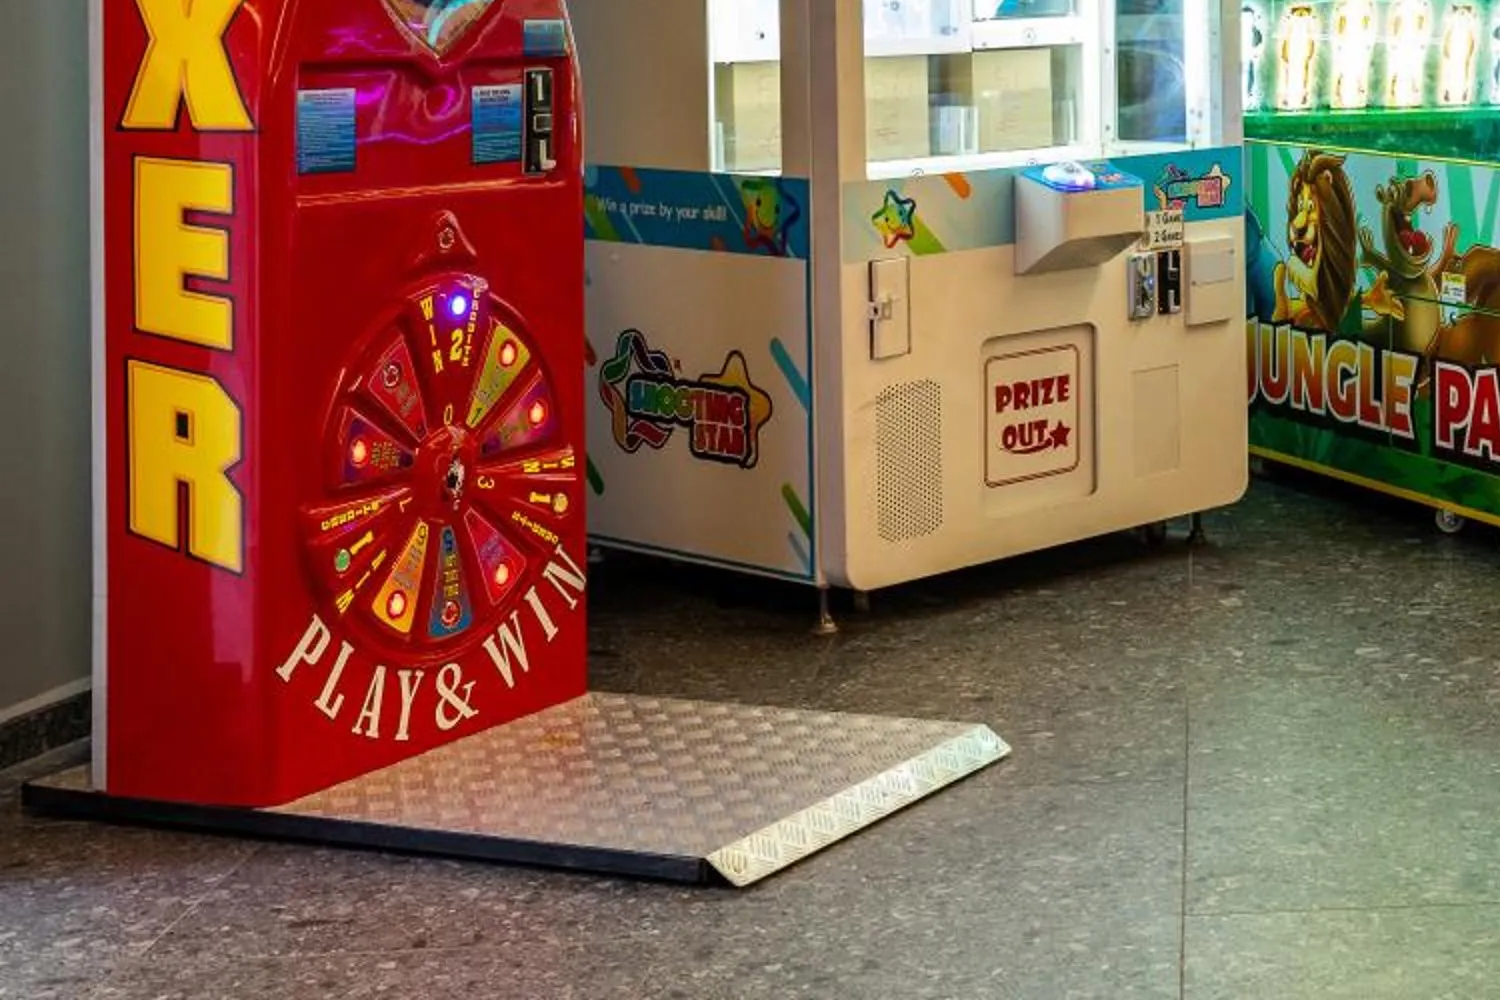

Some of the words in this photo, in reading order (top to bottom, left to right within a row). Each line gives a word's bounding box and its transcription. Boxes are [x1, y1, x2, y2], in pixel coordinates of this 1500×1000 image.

[629, 201, 657, 218] prize
[659, 201, 673, 220] by
[675, 206, 700, 223] your
[420, 295, 444, 375] WIN
[450, 329, 463, 361] 2
[994, 373, 1070, 414] PRIZE
[1001, 419, 1048, 450] OUT
[275, 613, 424, 741] PLAY
[435, 662, 480, 731] &
[482, 543, 588, 690] WIN
